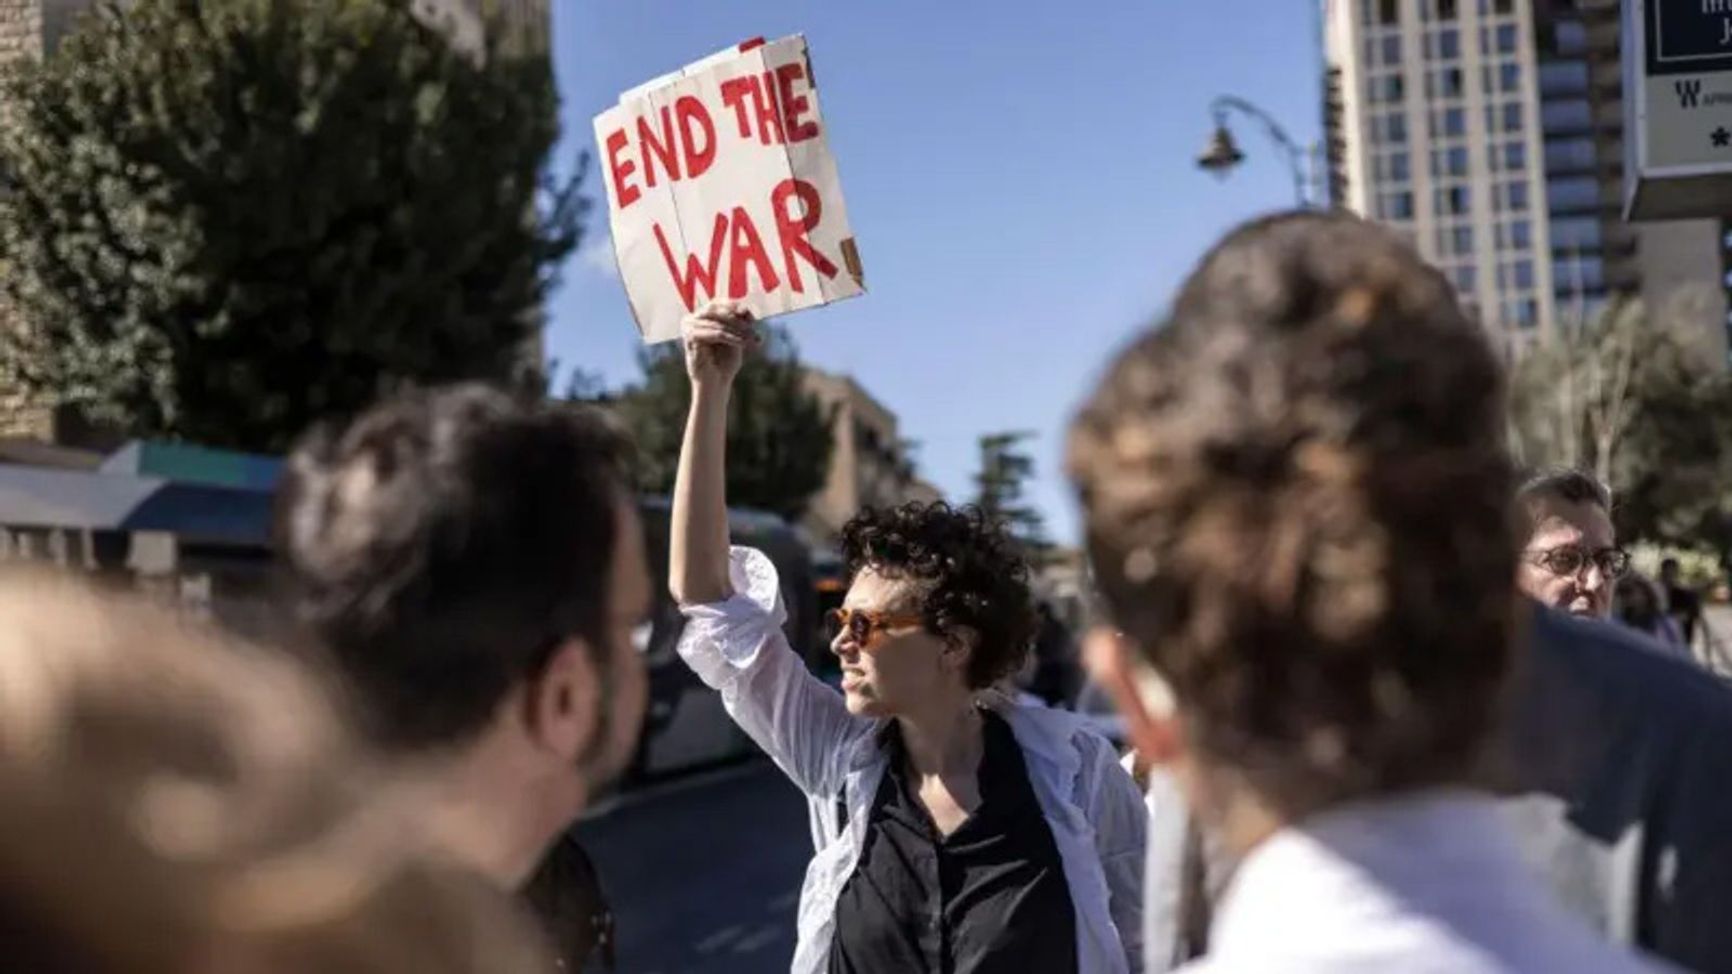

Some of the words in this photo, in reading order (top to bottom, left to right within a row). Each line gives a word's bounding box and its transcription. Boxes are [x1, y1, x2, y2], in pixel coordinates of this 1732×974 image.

[606, 94, 717, 209] END
[720, 62, 818, 146] THE
[653, 177, 839, 314] WAR
